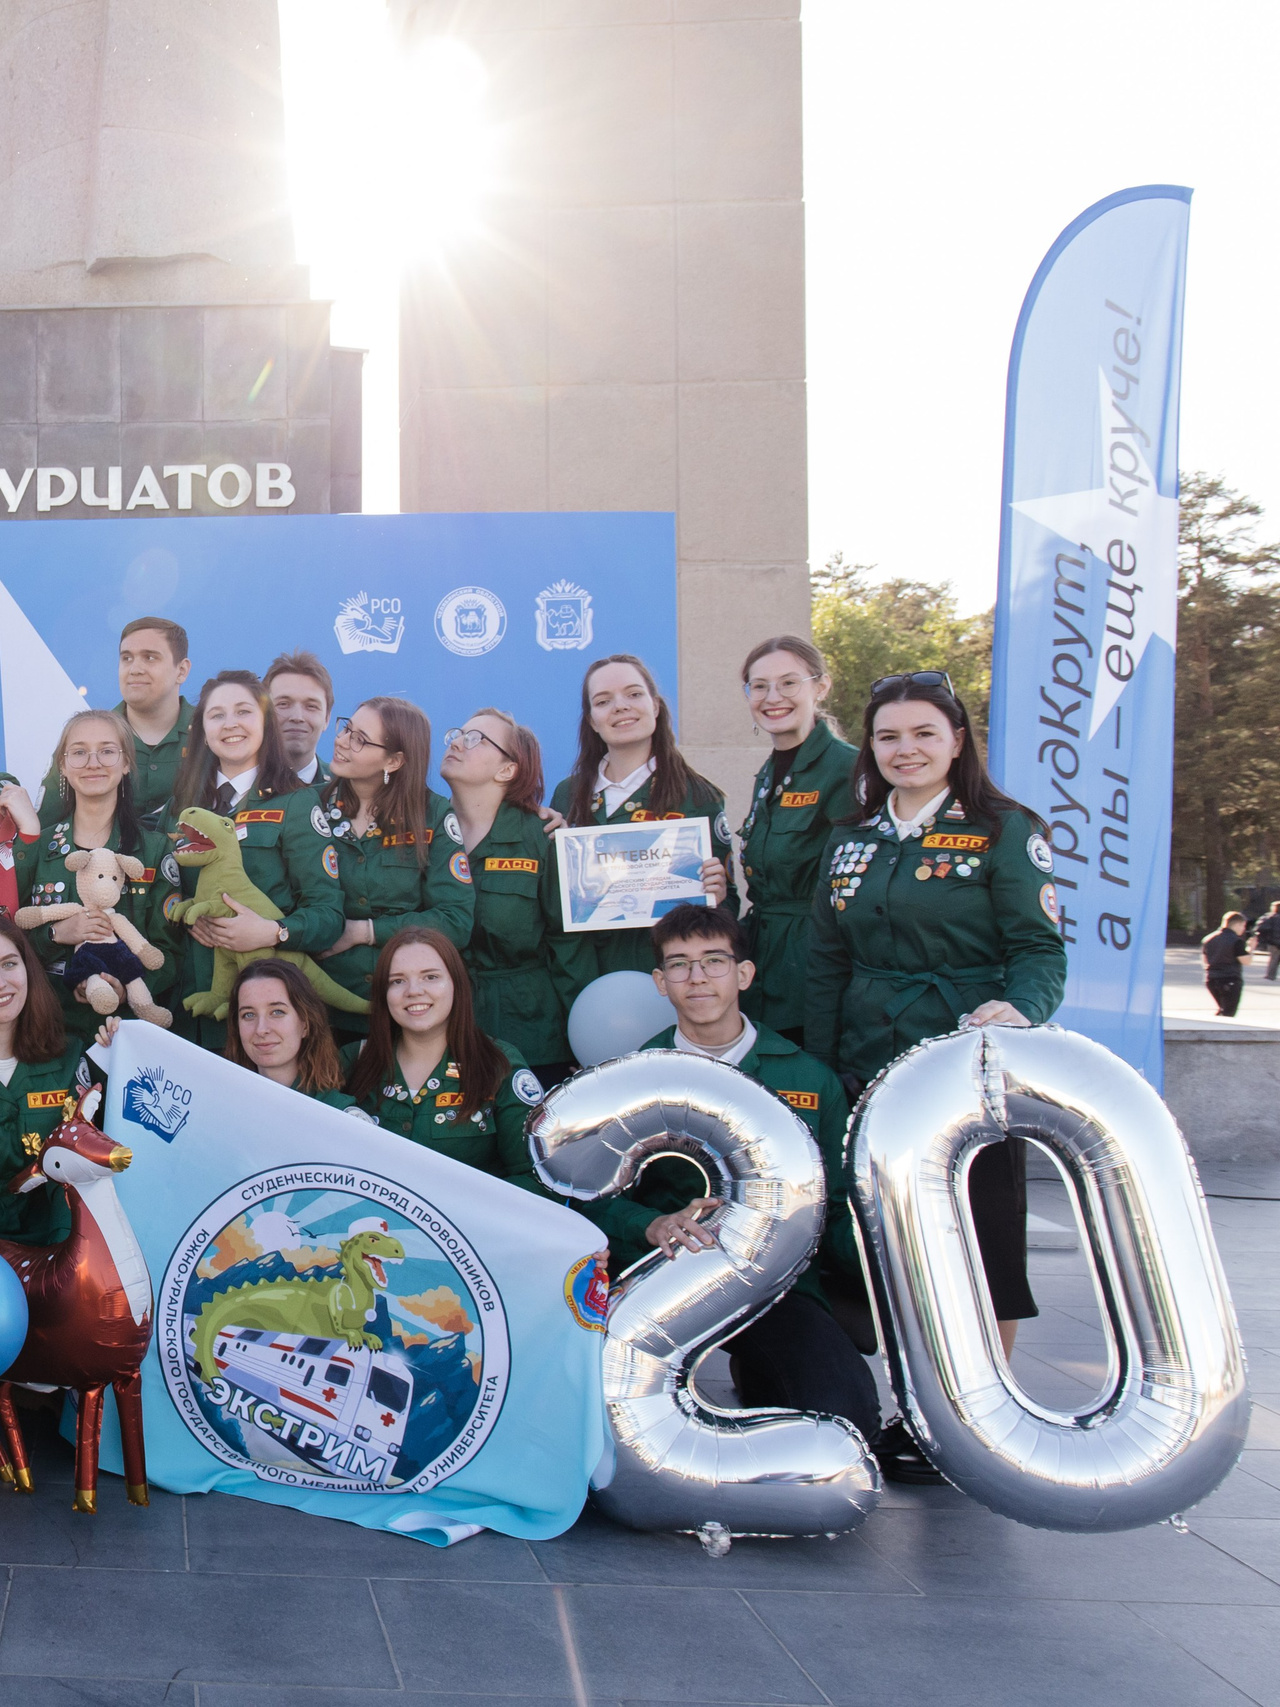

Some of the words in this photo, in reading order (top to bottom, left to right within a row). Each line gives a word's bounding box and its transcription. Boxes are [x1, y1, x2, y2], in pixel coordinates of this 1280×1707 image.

[1104, 298, 1151, 517] круче!
[371, 598, 402, 614] РСО
[1106, 538, 1144, 682] еще
[597, 847, 672, 864] ПУТЕВКА
[1100, 768, 1130, 888] ты
[1098, 912, 1131, 951] а
[162, 1079, 192, 1105] РСО
[241, 1172, 355, 1201] СТУДЕНЧЕСКИЙ
[359, 1179, 410, 1212] ОТРЯД
[411, 1206, 495, 1312] ПРОВОДНИКОВ
[165, 1228, 210, 1378] ЮЖНО-УРАЛЬСКОГО
[175, 1381, 297, 1484] ГОСУДАРСТВЕННОГО
[206, 1376, 388, 1482] ЭКСТРИМ
[429, 1374, 499, 1479] УНИВЕРСИТЕТА
